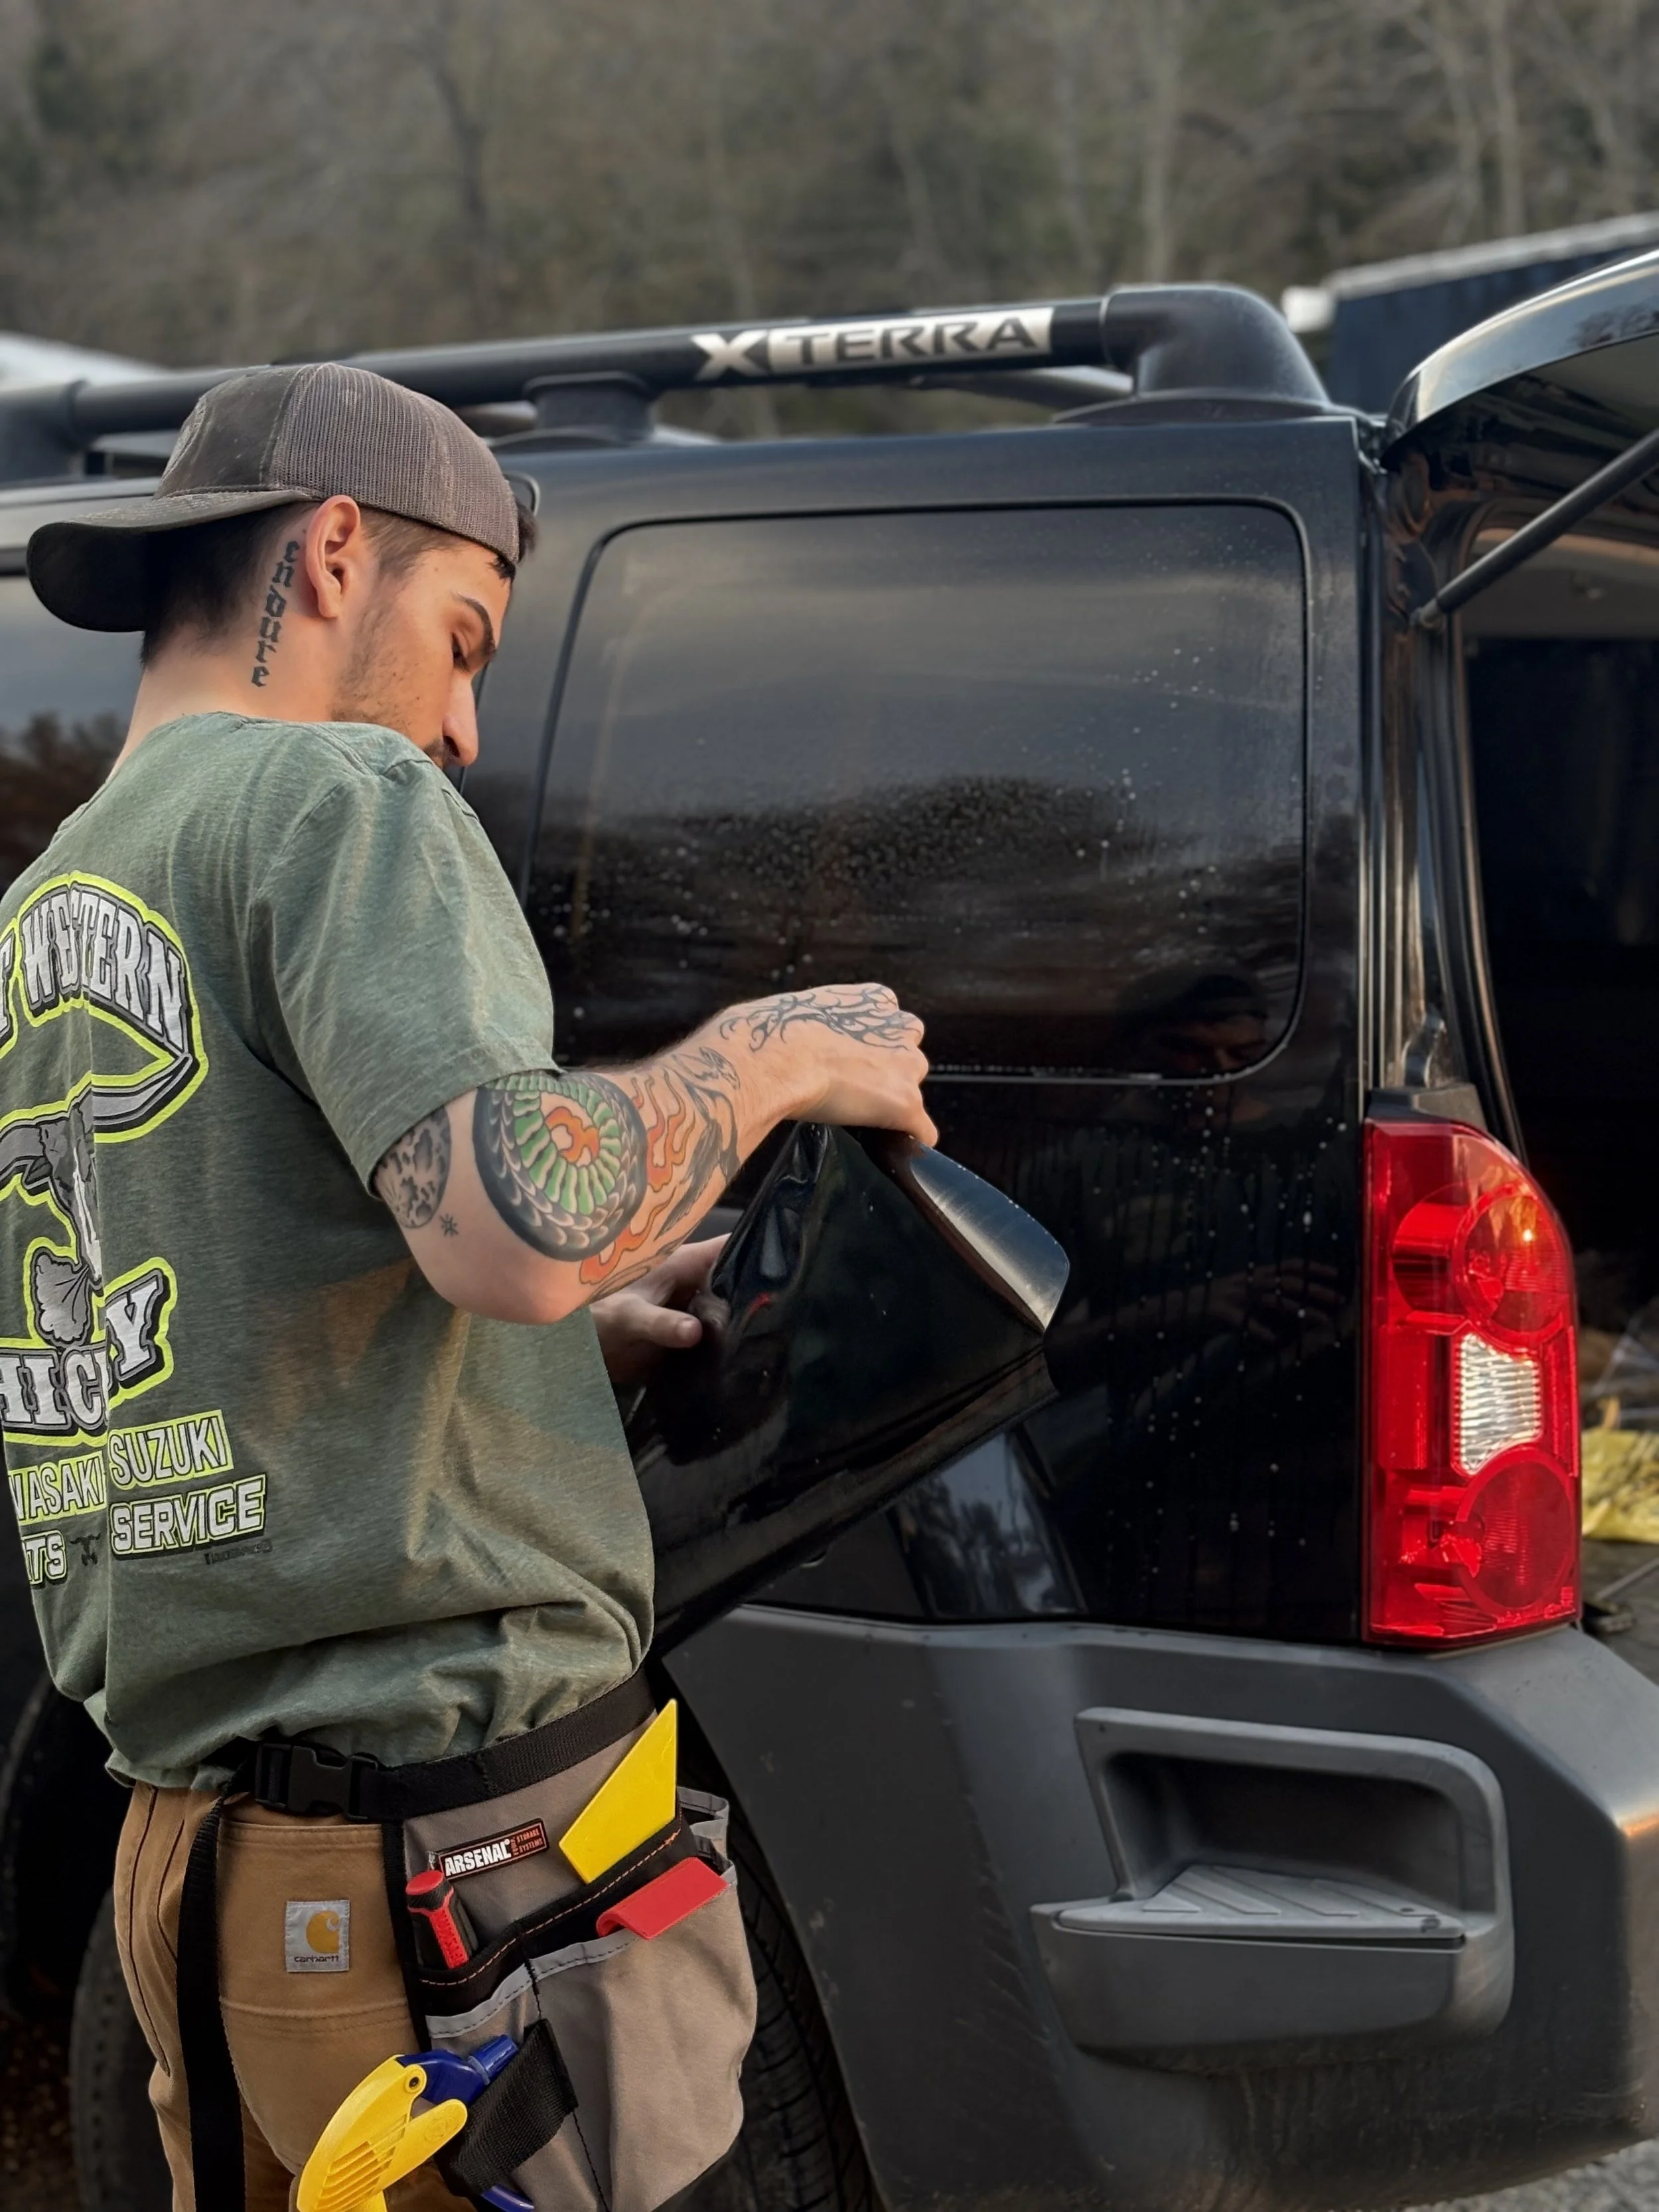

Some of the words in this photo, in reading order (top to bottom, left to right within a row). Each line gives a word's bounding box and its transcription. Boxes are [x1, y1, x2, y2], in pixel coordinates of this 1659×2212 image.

[690, 317, 1038, 381] XTERRA
[109, 1418, 230, 1487] SUZUKI
[111, 1479, 265, 1553] SERVICE
[444, 1838, 512, 1878] ARSENAL
